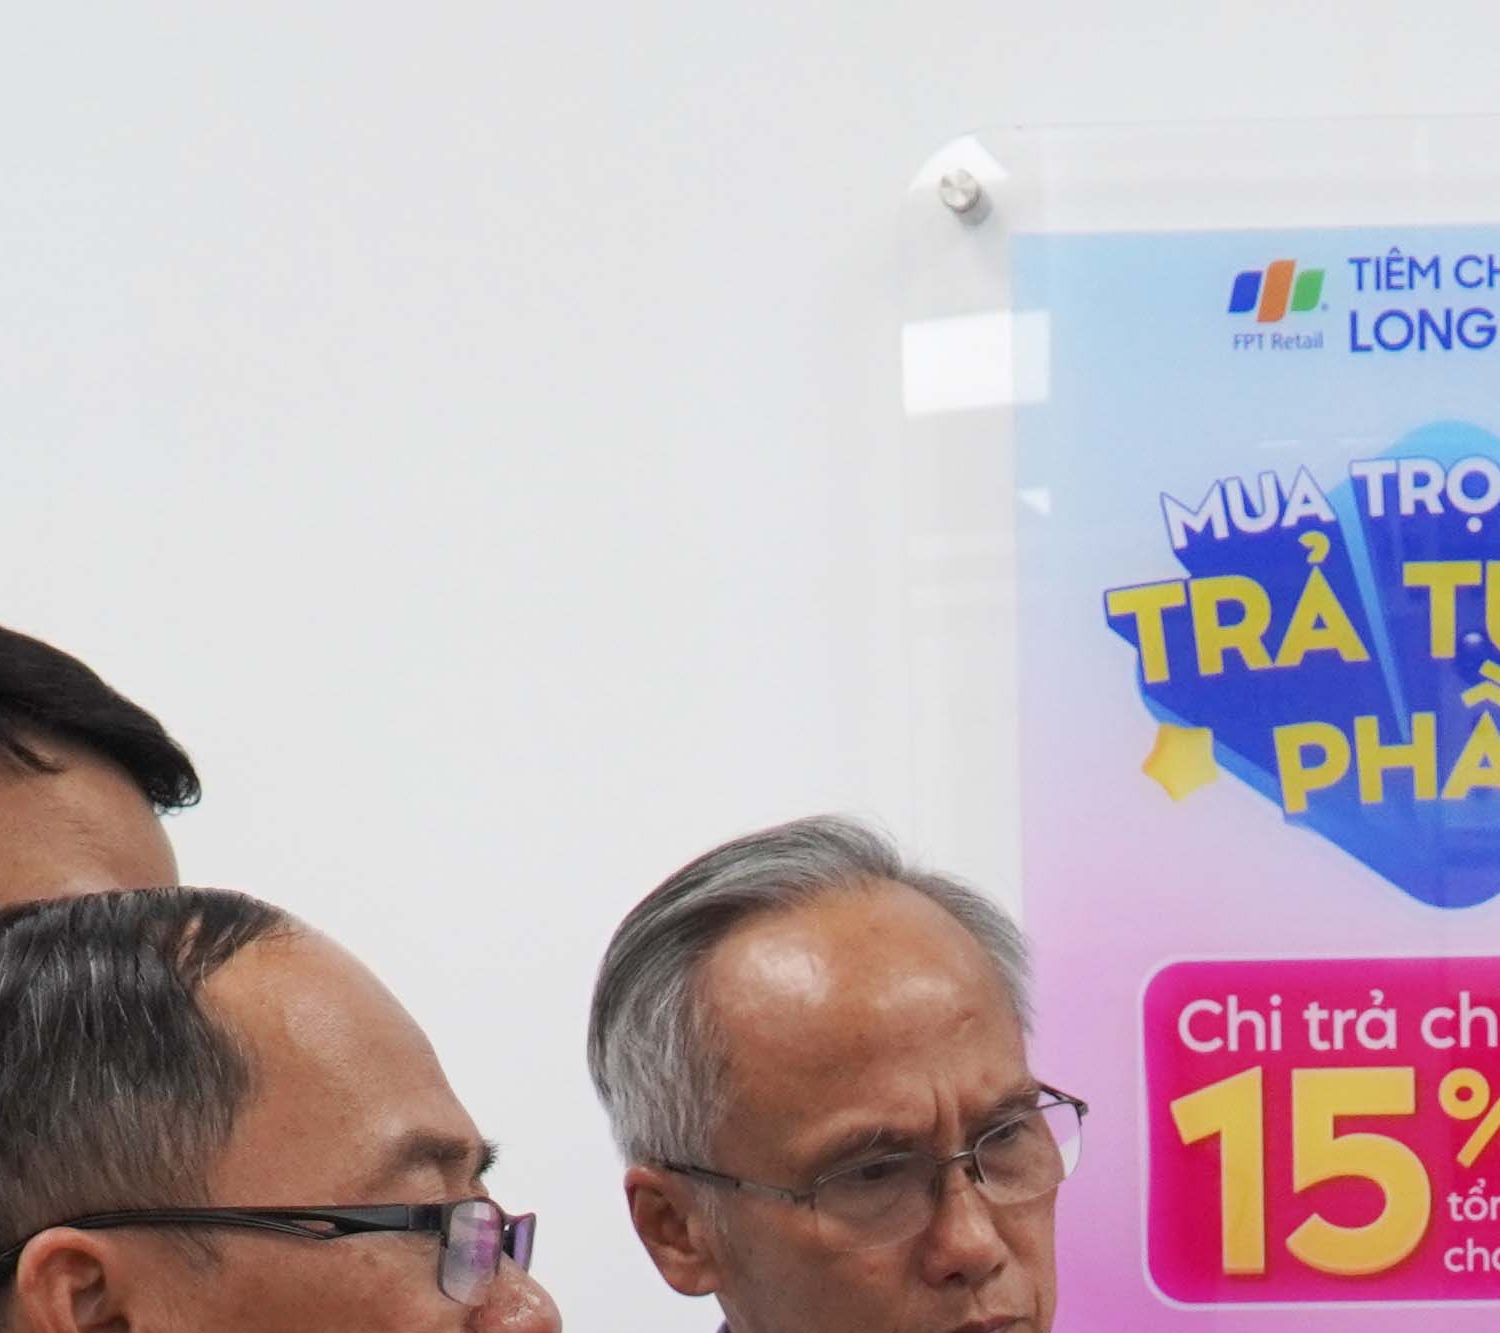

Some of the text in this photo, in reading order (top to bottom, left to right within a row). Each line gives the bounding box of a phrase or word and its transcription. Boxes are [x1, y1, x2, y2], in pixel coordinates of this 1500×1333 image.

[1348, 246, 1441, 293] TIÊM
[1232, 330, 1325, 351] FPT Retail
[1349, 306, 1498, 353] LONG
[1160, 464, 1337, 551] MUA
[1103, 531, 1370, 685] TRẢ
[1177, 995, 1283, 1053] Chi
[1302, 989, 1398, 1051] trả
